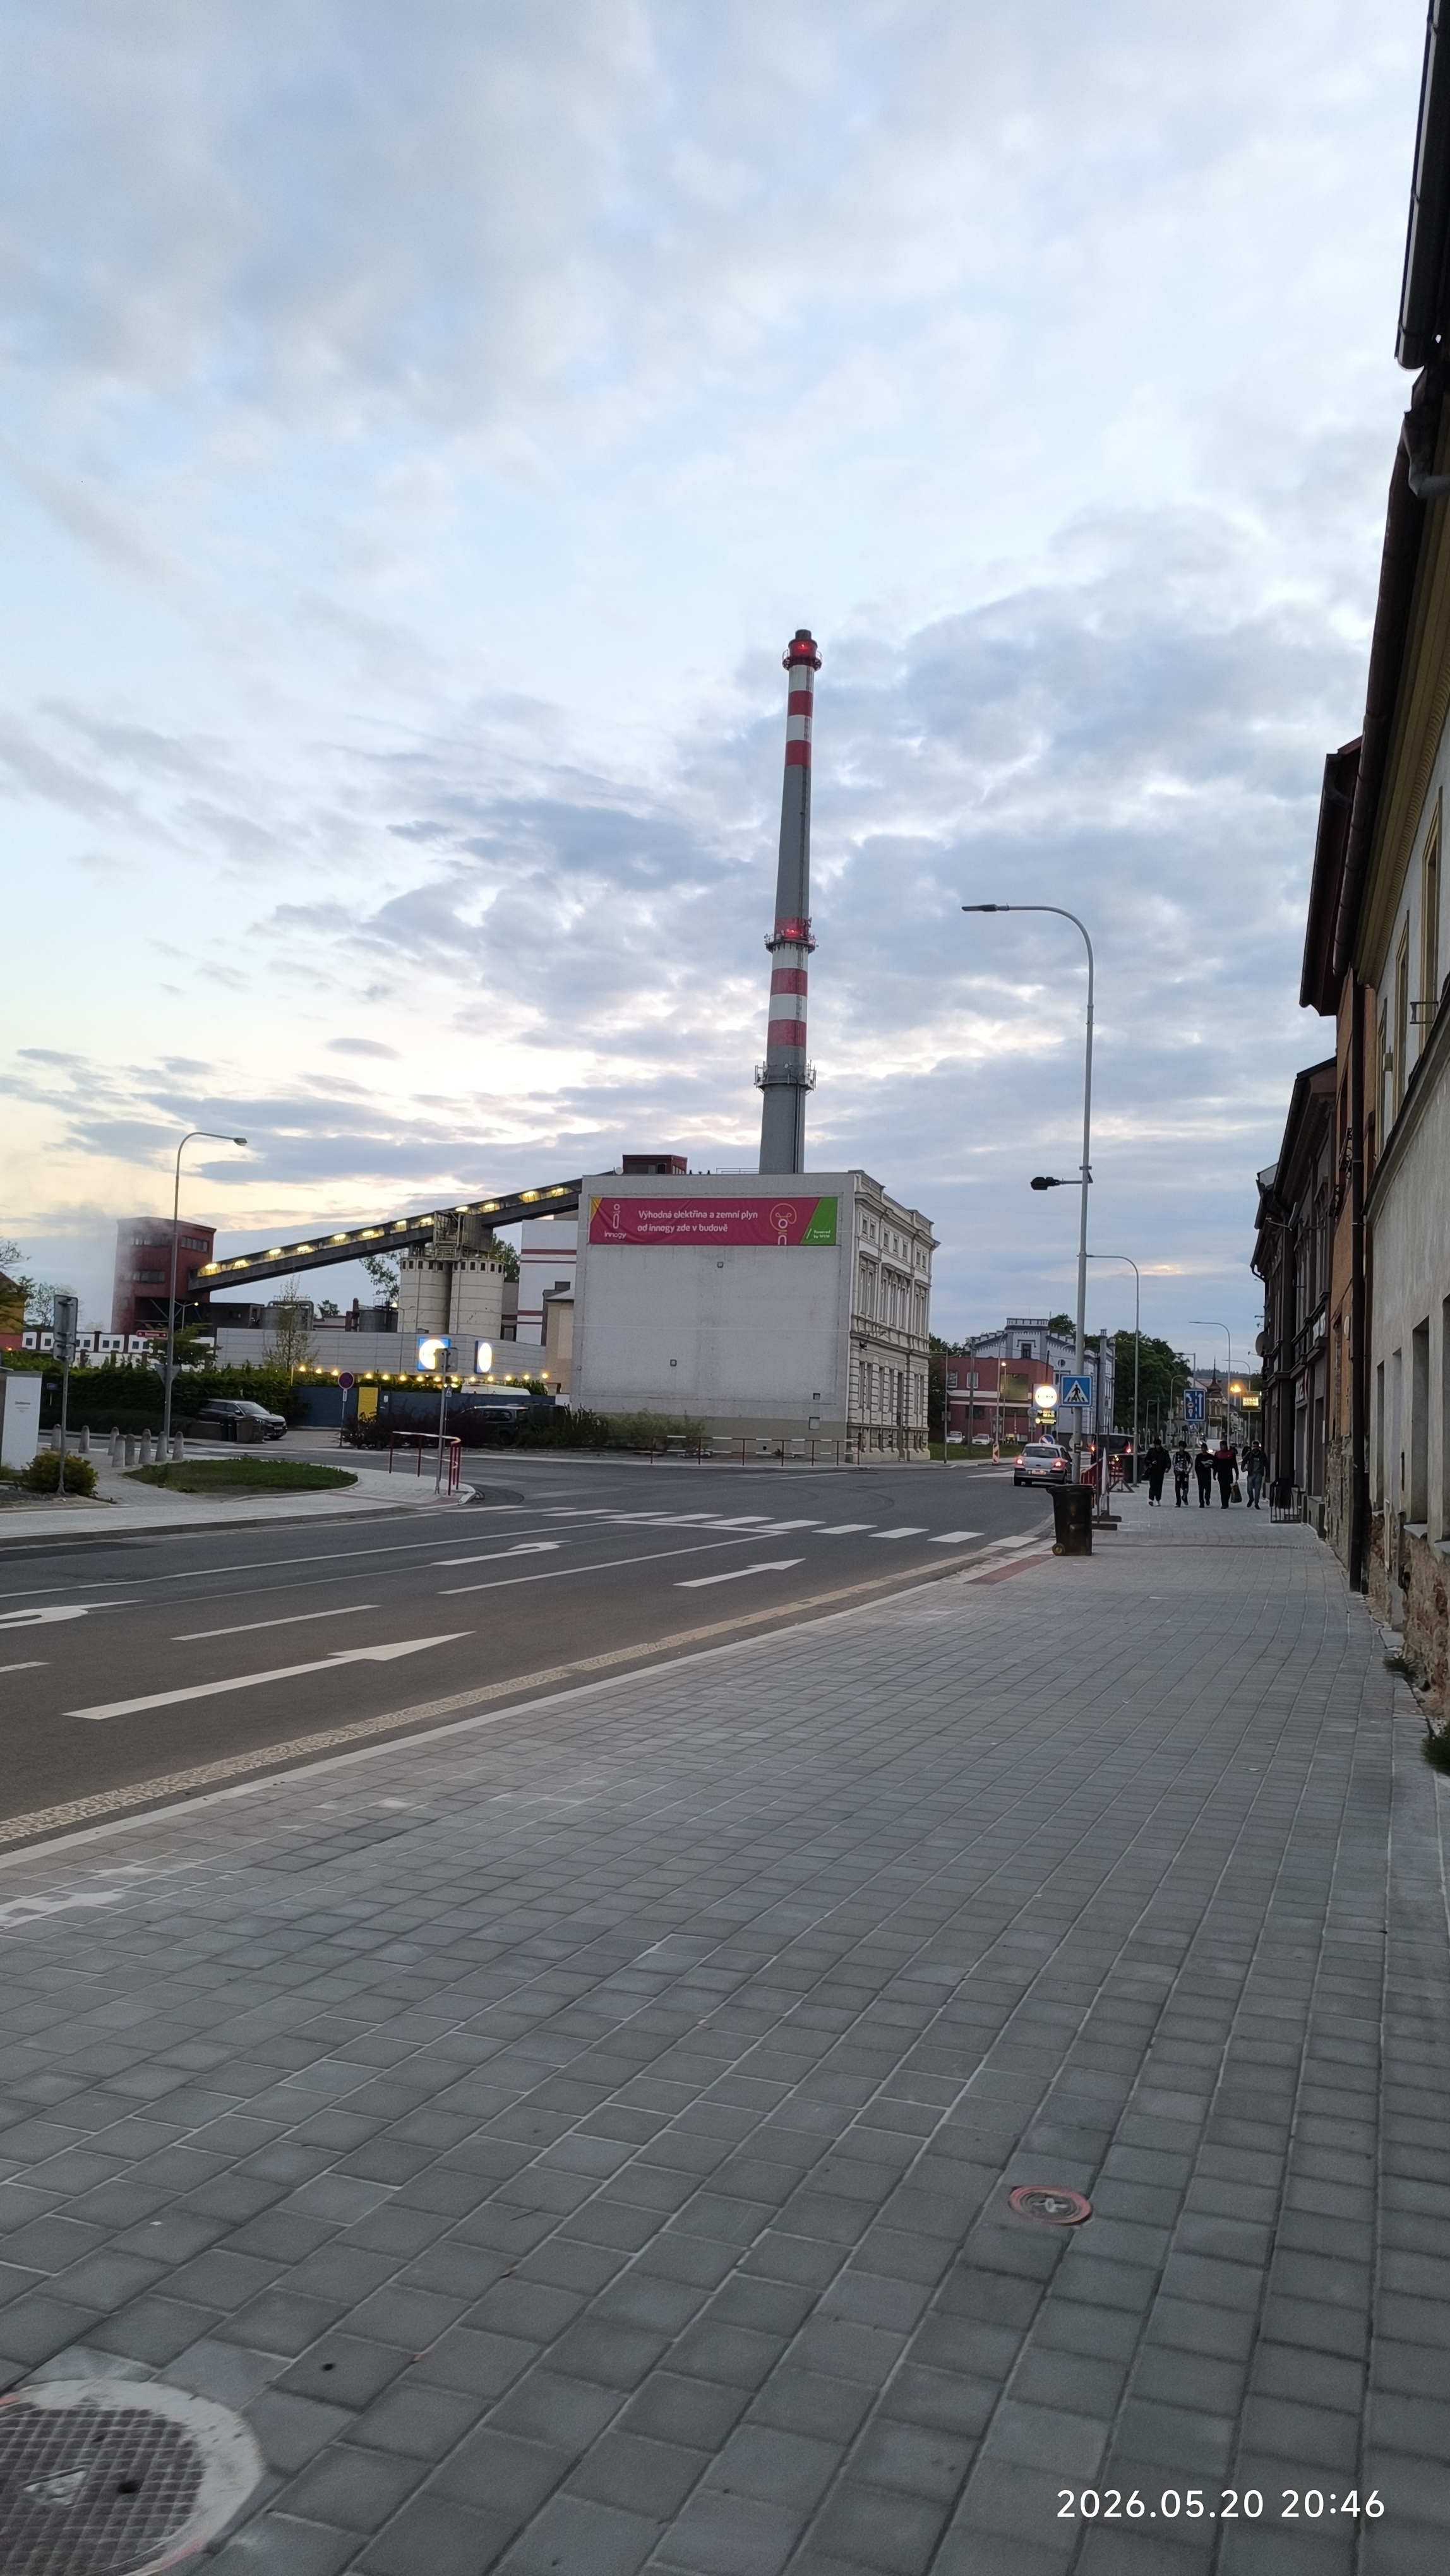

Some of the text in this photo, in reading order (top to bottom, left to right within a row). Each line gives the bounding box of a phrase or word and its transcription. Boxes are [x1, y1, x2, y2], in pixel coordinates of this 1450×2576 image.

[638, 1210, 672, 1220] Výhodná
[673, 1210, 707, 1219] elektřina
[716, 1210, 740, 1219] zemní
[741, 1210, 758, 1220] plyn
[637, 1224, 648, 1232] od
[649, 1224, 675, 1234] innogy
[676, 1224, 691, 1232] zde
[698, 1224, 728, 1232] budově
[604, 1231, 627, 1239] innogy
